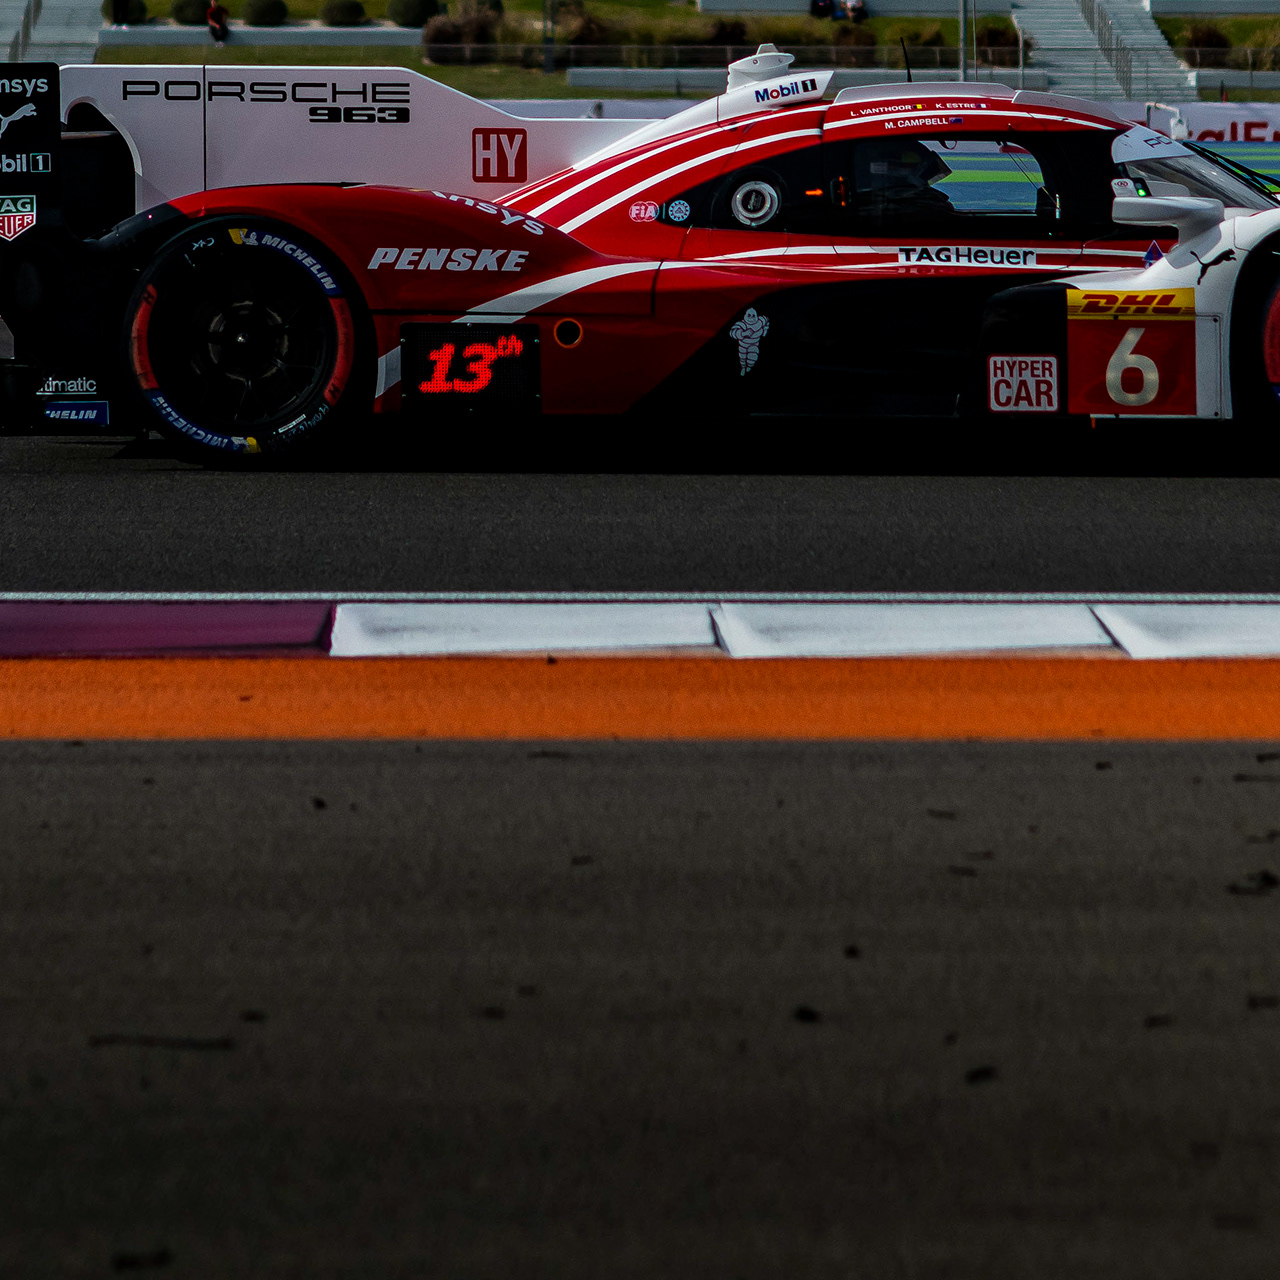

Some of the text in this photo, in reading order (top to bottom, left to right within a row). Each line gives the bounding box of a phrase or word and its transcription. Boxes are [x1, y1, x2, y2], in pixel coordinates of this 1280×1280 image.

[122, 80, 410, 103] PORSCHE
[755, 81, 800, 103] Mobil
[308, 107, 410, 123] 963
[860, 104, 911, 115] VANTHOOR
[898, 118, 948, 128] CAMPBELL
[475, 133, 523, 177] HY
[261, 233, 336, 290] MICHELIN
[368, 248, 529, 271] PENSKE
[1081, 294, 1179, 314] DHL
[419, 333, 523, 394] 13th
[993, 361, 1053, 378] HYPER
[1105, 327, 1159, 406] 6
[993, 379, 1054, 407] CAR
[46, 410, 98, 420] HELIN
[151, 395, 230, 449] MICHELIN
